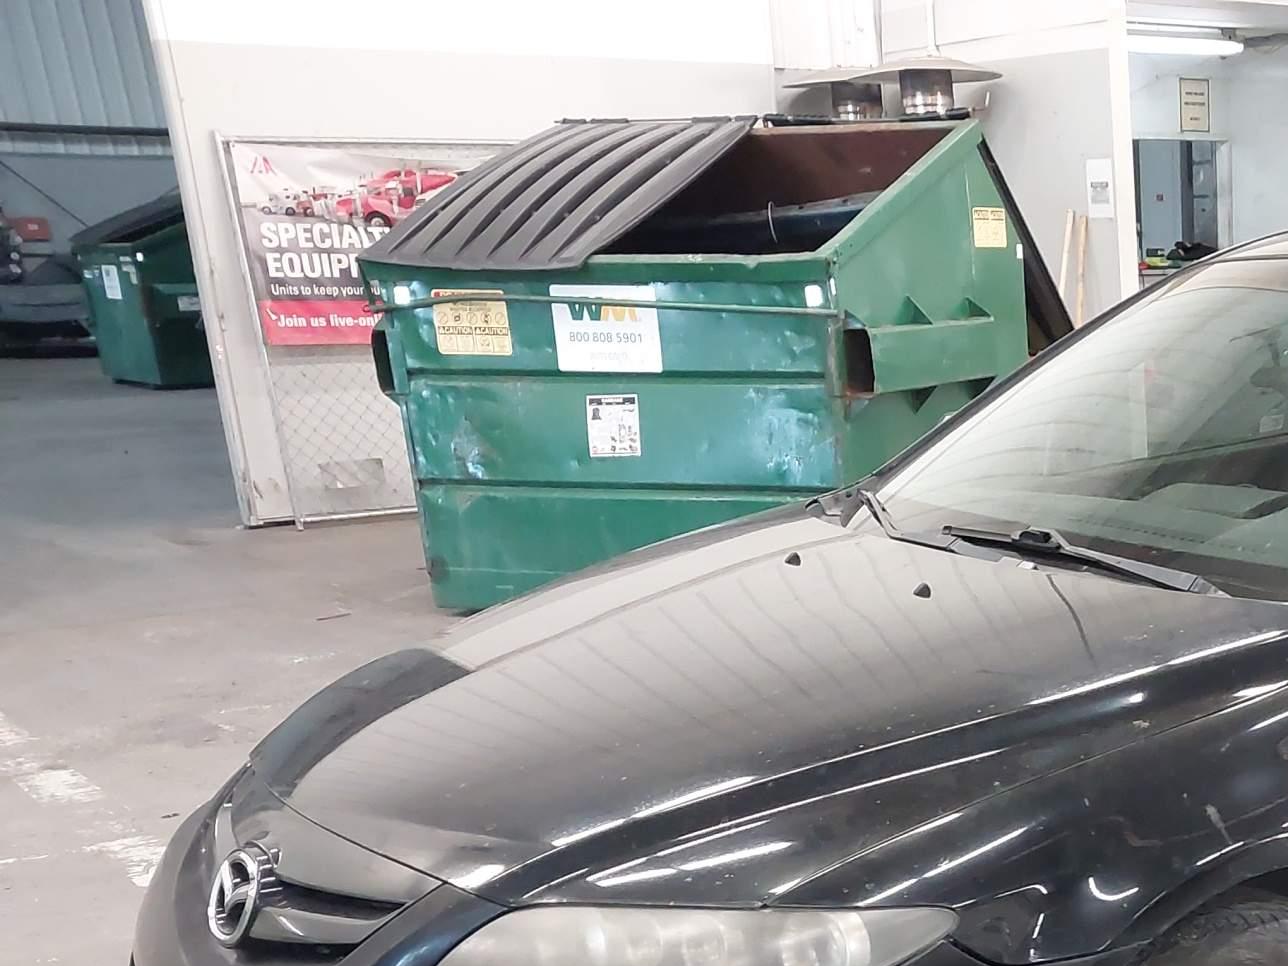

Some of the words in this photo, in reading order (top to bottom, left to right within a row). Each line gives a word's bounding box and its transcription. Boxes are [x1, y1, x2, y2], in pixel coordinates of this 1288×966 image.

[260, 222, 391, 249] SPECIALT
[271, 284, 300, 296] Units
[300, 285, 311, 296] to
[312, 284, 340, 298] keep
[340, 287, 364, 298] your
[277, 314, 307, 328] Join
[310, 316, 327, 327] us
[445, 327, 473, 335] CAUTION
[481, 328, 508, 336] CAUTION
[569, 332, 590, 342] 800
[592, 332, 614, 343] 808
[616, 332, 643, 343] 5901
